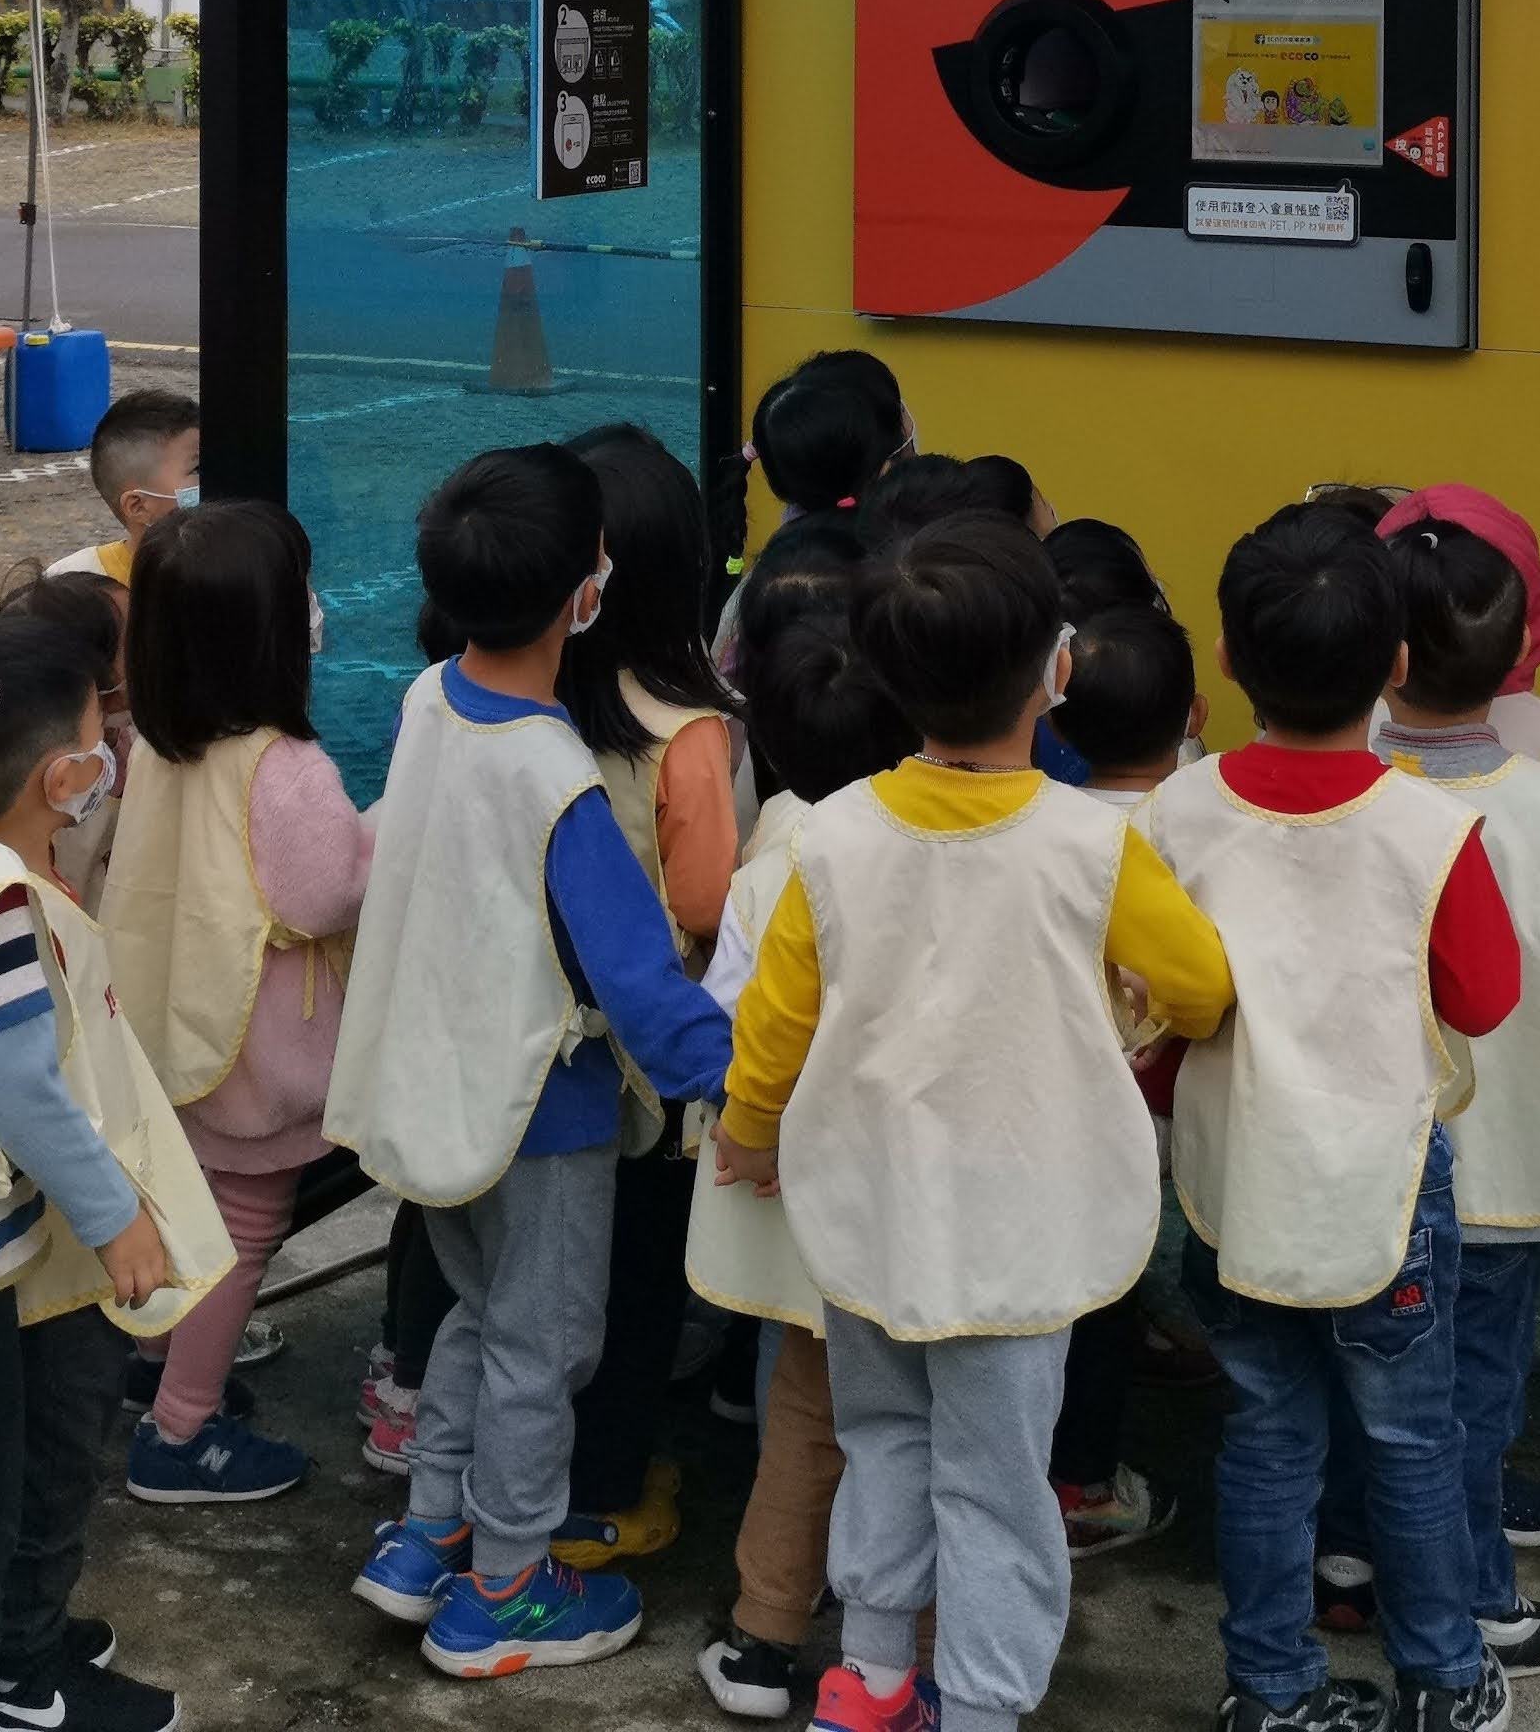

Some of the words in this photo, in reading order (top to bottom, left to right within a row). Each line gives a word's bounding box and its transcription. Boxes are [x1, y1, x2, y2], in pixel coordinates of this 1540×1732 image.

[560, 6, 567, 26] 2
[560, 93, 566, 112] 3
[1195, 199, 1321, 217] 使用前請登入會員帳號
